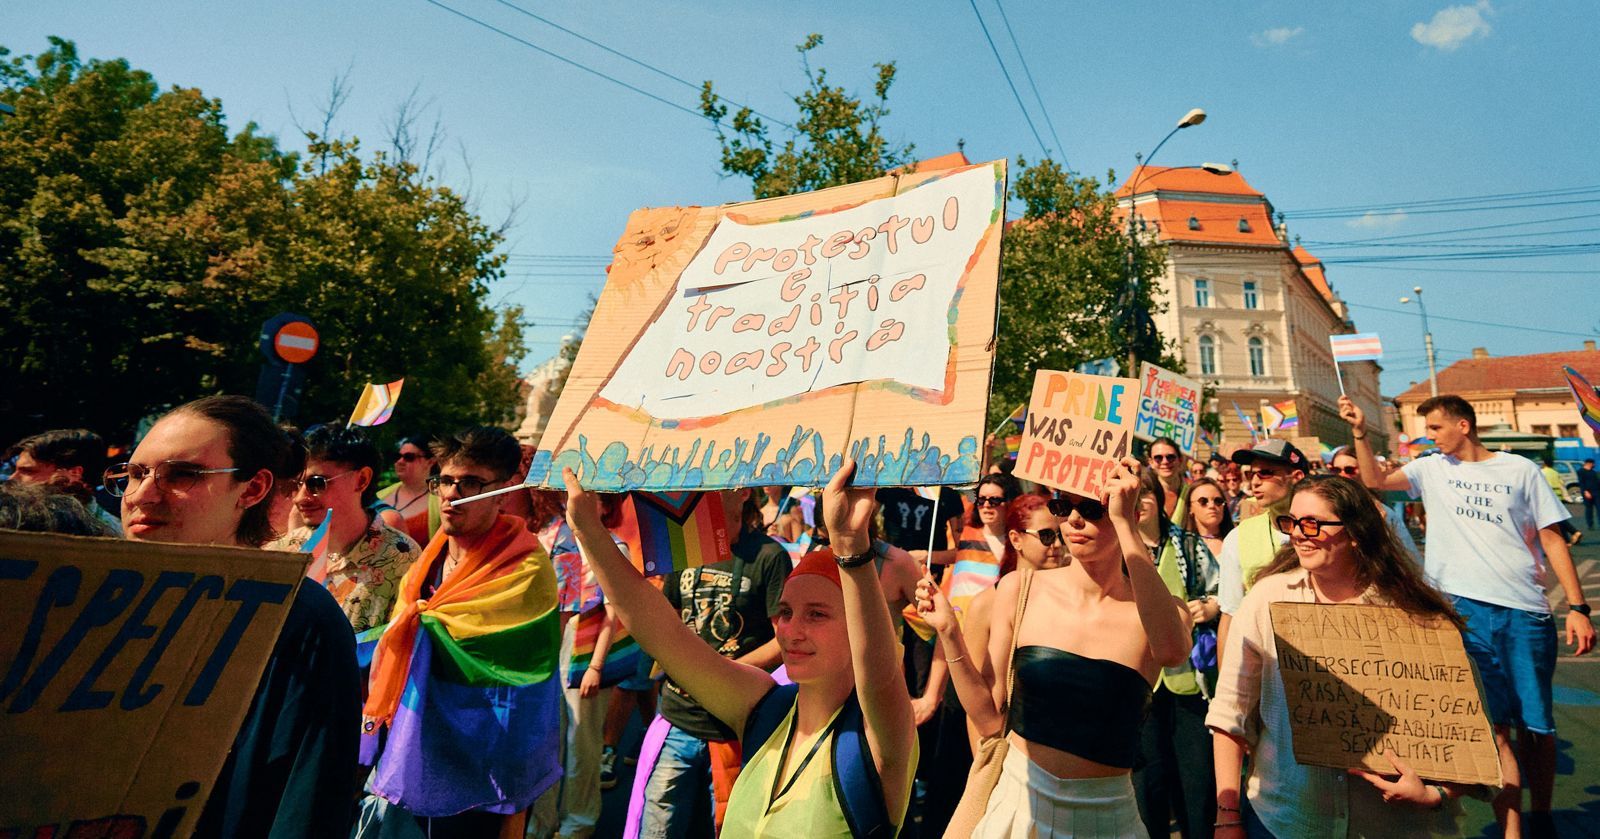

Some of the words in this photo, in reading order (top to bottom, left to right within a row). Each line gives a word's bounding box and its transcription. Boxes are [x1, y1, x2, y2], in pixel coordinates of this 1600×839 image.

[665, 318, 905, 381] noastră
[1043, 374, 1125, 425] PRIDE
[1141, 399, 1195, 427] CASTIGA
[1029, 412, 1072, 446] WAS
[1069, 434, 1088, 448] and
[1091, 429, 1113, 455] IS
[1113, 430, 1128, 461] A
[1025, 442, 1115, 497] PROTES
[1456, 506, 1504, 524] DOLLS
[1465, 496, 1494, 508] THE
[0, 560, 293, 714] SPECT
